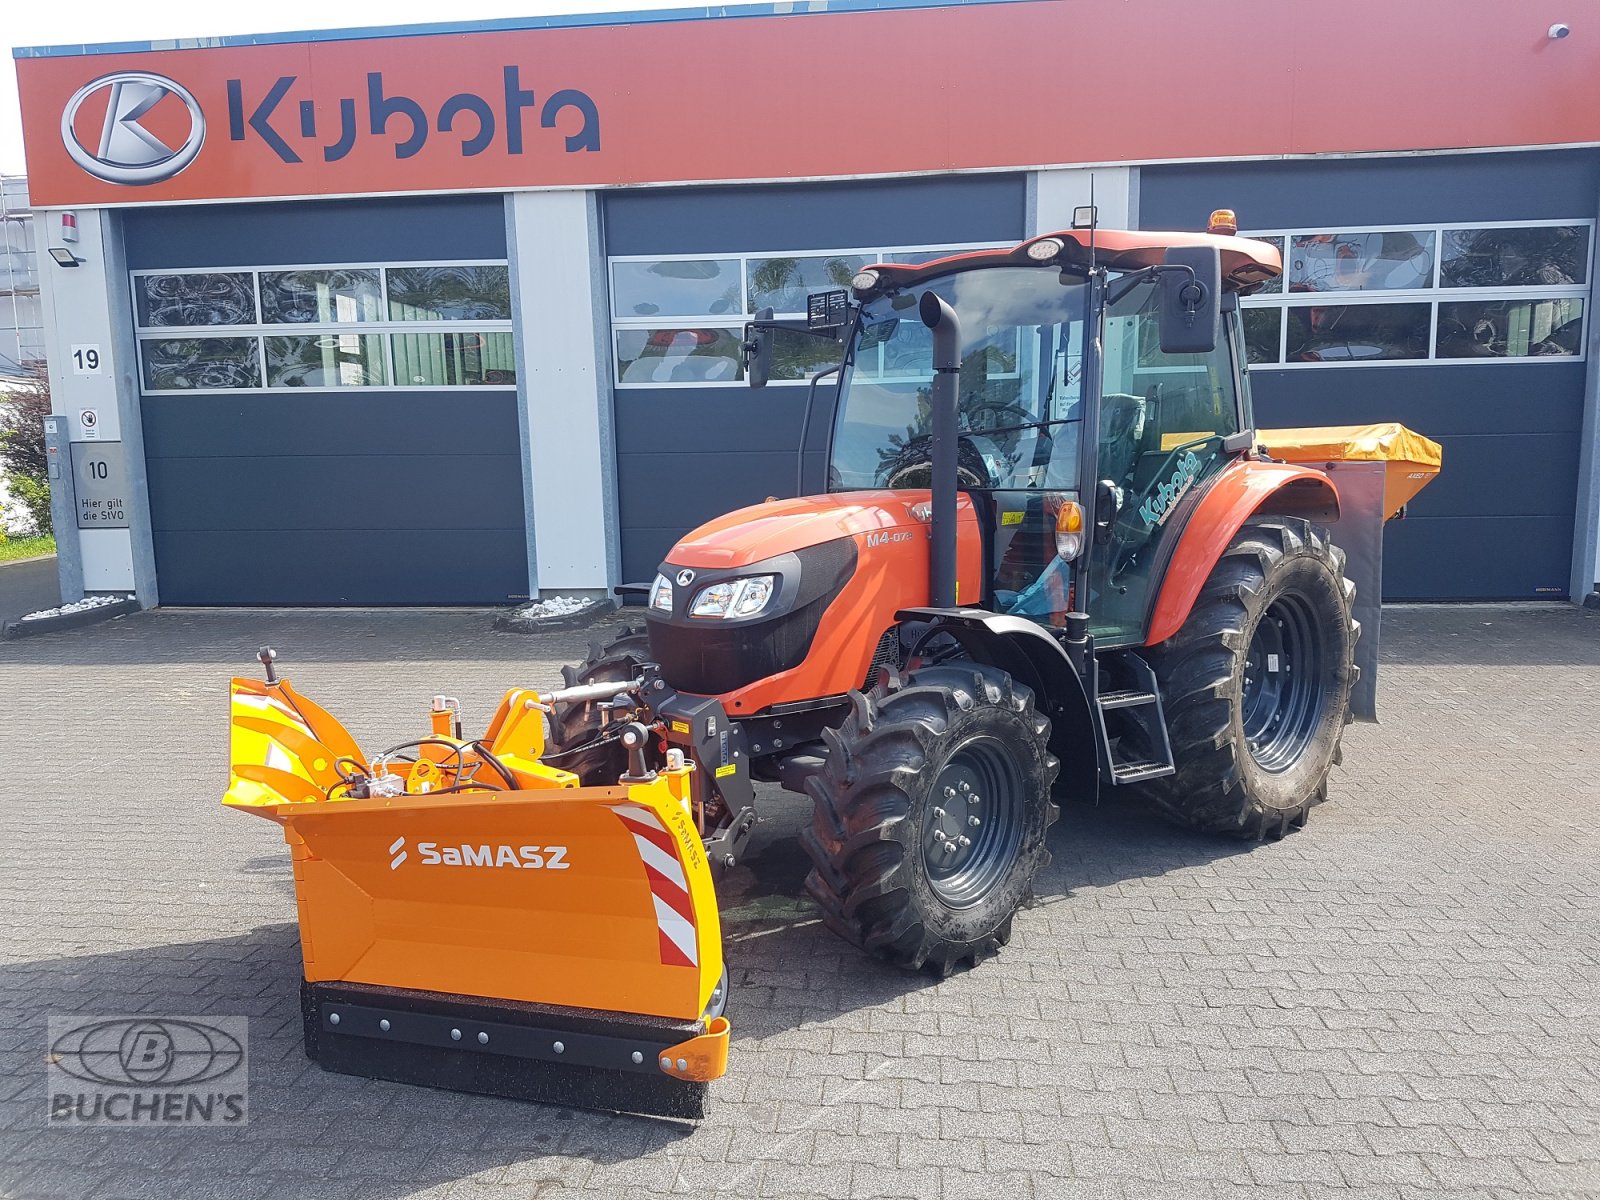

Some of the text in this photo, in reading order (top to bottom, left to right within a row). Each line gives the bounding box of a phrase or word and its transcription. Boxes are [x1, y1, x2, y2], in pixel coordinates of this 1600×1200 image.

[226, 64, 602, 164] Kubota
[73, 349, 99, 370] 19
[89, 461, 108, 480] 10
[1139, 451, 1202, 527] Kubota
[81, 498, 123, 510] Hier gilt
[83, 510, 124, 520] die StVO
[417, 842, 571, 870] SaMASZ
